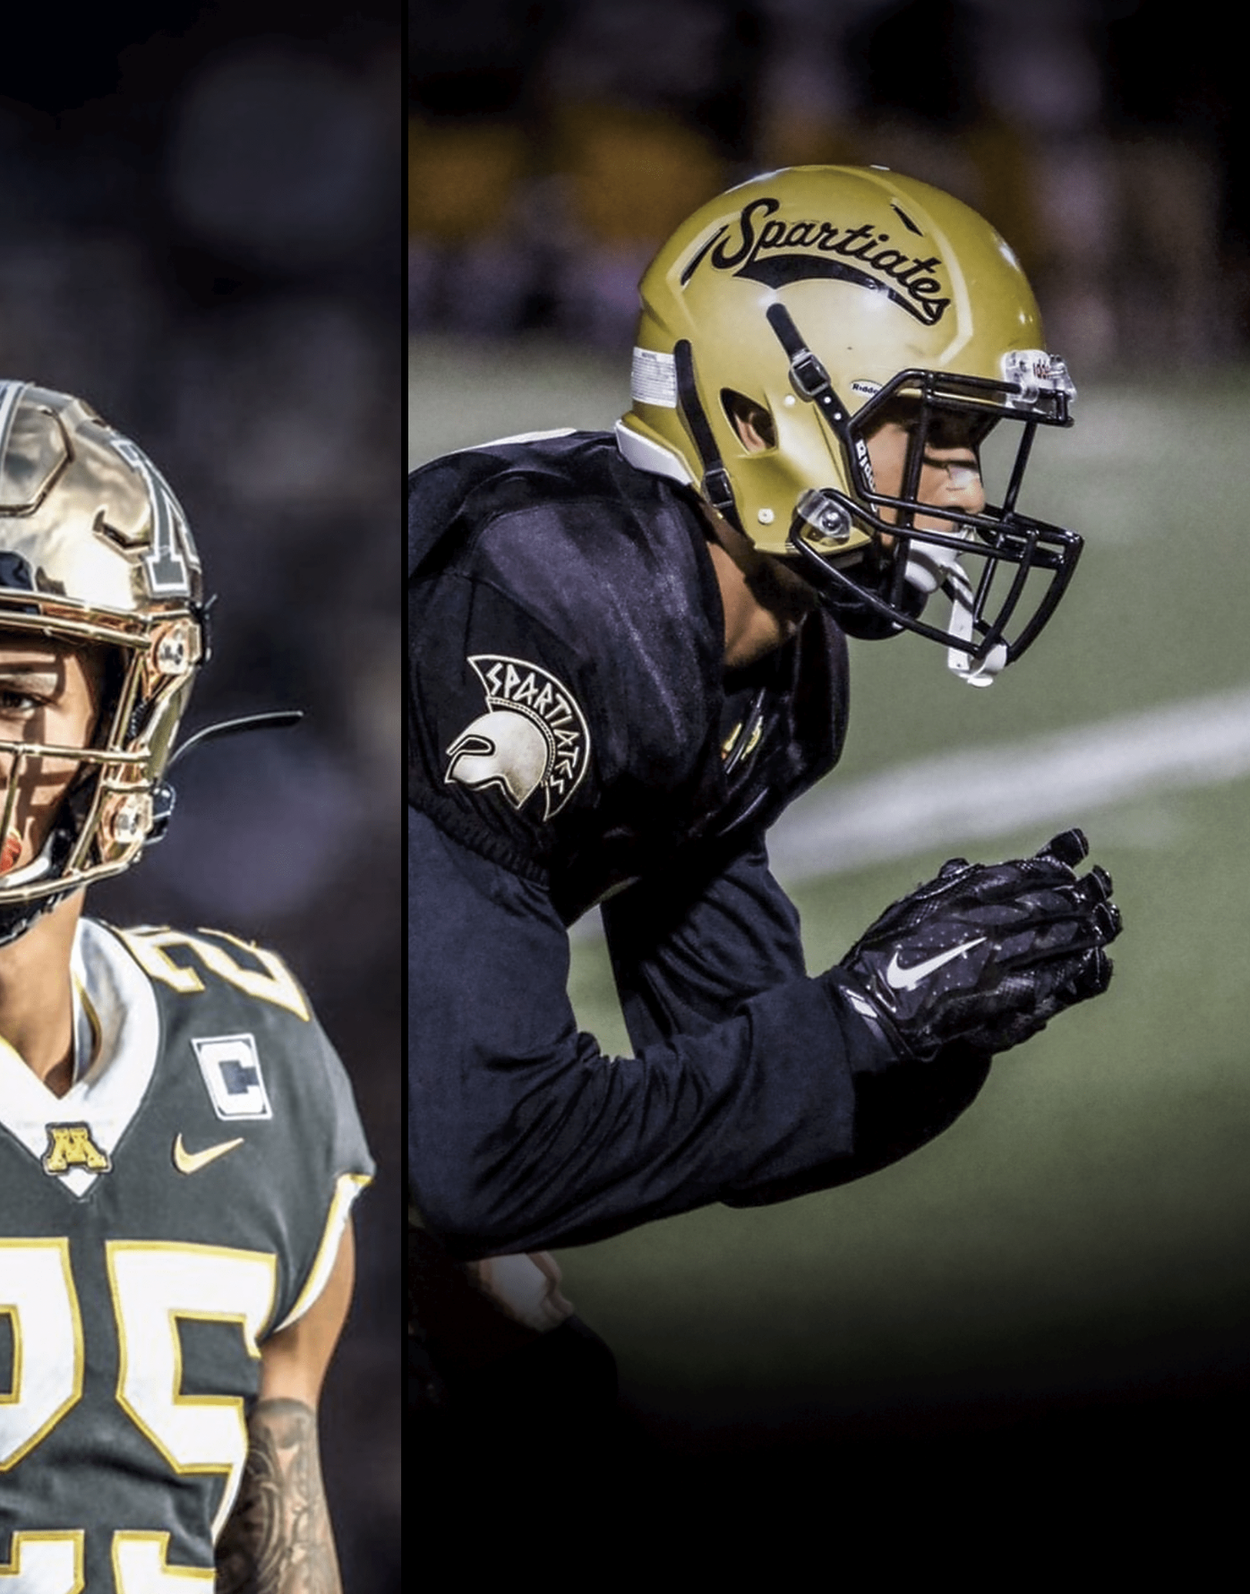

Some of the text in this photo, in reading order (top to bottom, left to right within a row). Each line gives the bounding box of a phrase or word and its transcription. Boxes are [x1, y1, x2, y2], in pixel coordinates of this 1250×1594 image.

[712, 197, 951, 326] Spartiates
[486, 662, 580, 795] SPARTIATES
[199, 1041, 265, 1115] C
[46, 1126, 108, 1171] M
